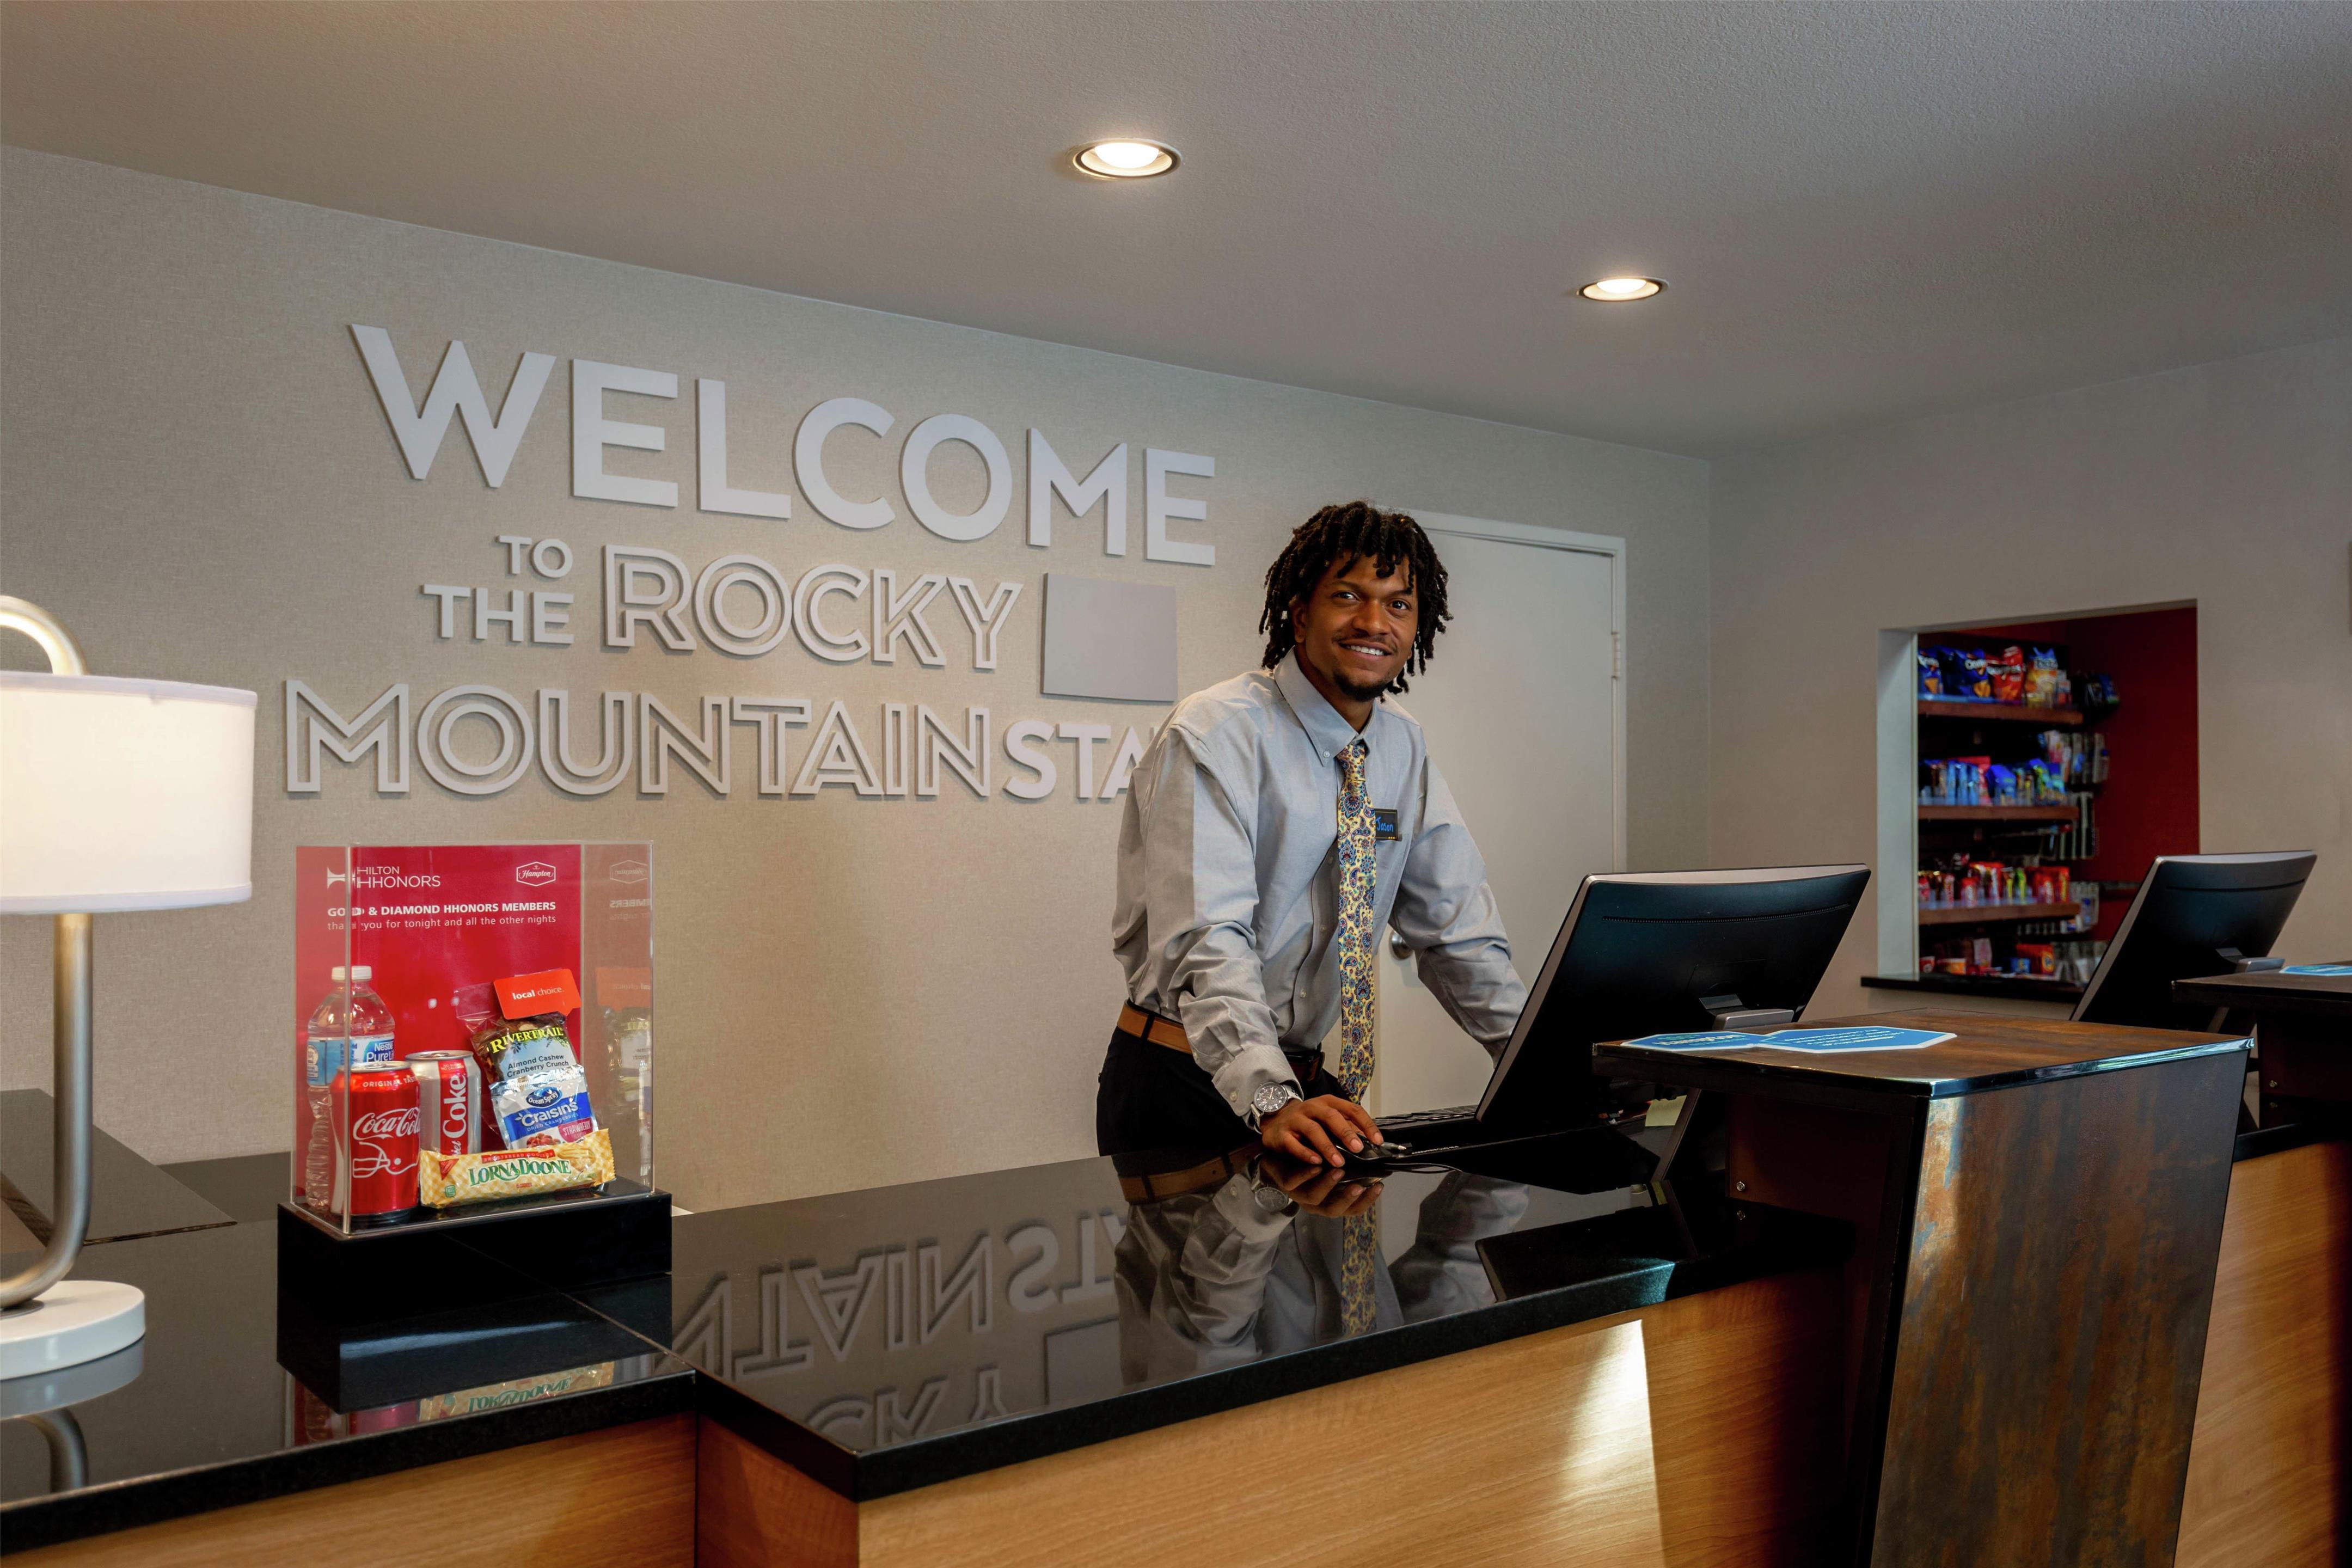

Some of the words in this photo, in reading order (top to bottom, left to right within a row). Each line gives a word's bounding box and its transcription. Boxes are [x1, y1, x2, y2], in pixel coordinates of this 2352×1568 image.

[350, 323, 1216, 567] WELCOME
[498, 535, 573, 579] TO
[421, 584, 575, 646] THE
[603, 544, 1023, 670] ROCKY
[285, 678, 991, 798] MOUNTAIN
[1003, 720, 1159, 800] STA
[1375, 816, 1394, 832] Jason
[357, 866, 400, 875] HILTON
[357, 875, 441, 889] HHONORS
[519, 869, 554, 879] Hampton
[327, 907, 365, 917] GOD
[368, 906, 377, 915] &
[381, 905, 440, 916] DIAMOND
[444, 903, 499, 914] HHONORS
[502, 902, 556, 911] MEMBERS
[327, 922, 357, 930] tha
[362, 922, 382, 931] you
[386, 920, 401, 928] for
[405, 918, 441, 929] tonight
[444, 917, 462, 927] and
[465, 917, 477, 926] all
[481, 916, 496, 925] the
[499, 916, 524, 924] other
[528, 915, 556, 925] nights
[512, 989, 536, 1000] local
[507, 1057, 537, 1070] Almond
[538, 1054, 564, 1062] Cashew
[507, 1063, 544, 1078] Cranberry
[546, 1060, 569, 1068] Crunch
[363, 1079, 403, 1088] ORIGINAL
[528, 1095, 544, 1105] Ocean
[544, 1091, 559, 1104] Spray
[442, 1075, 467, 1138] Coke
[521, 1099, 579, 1127] Craisins
[526, 1123, 544, 1132] DRIED
[562, 1119, 591, 1136] STRAWBERRY
[451, 1141, 462, 1155] iet
[467, 1162, 519, 1187] LORNA
[518, 1159, 572, 1175] DOONE
